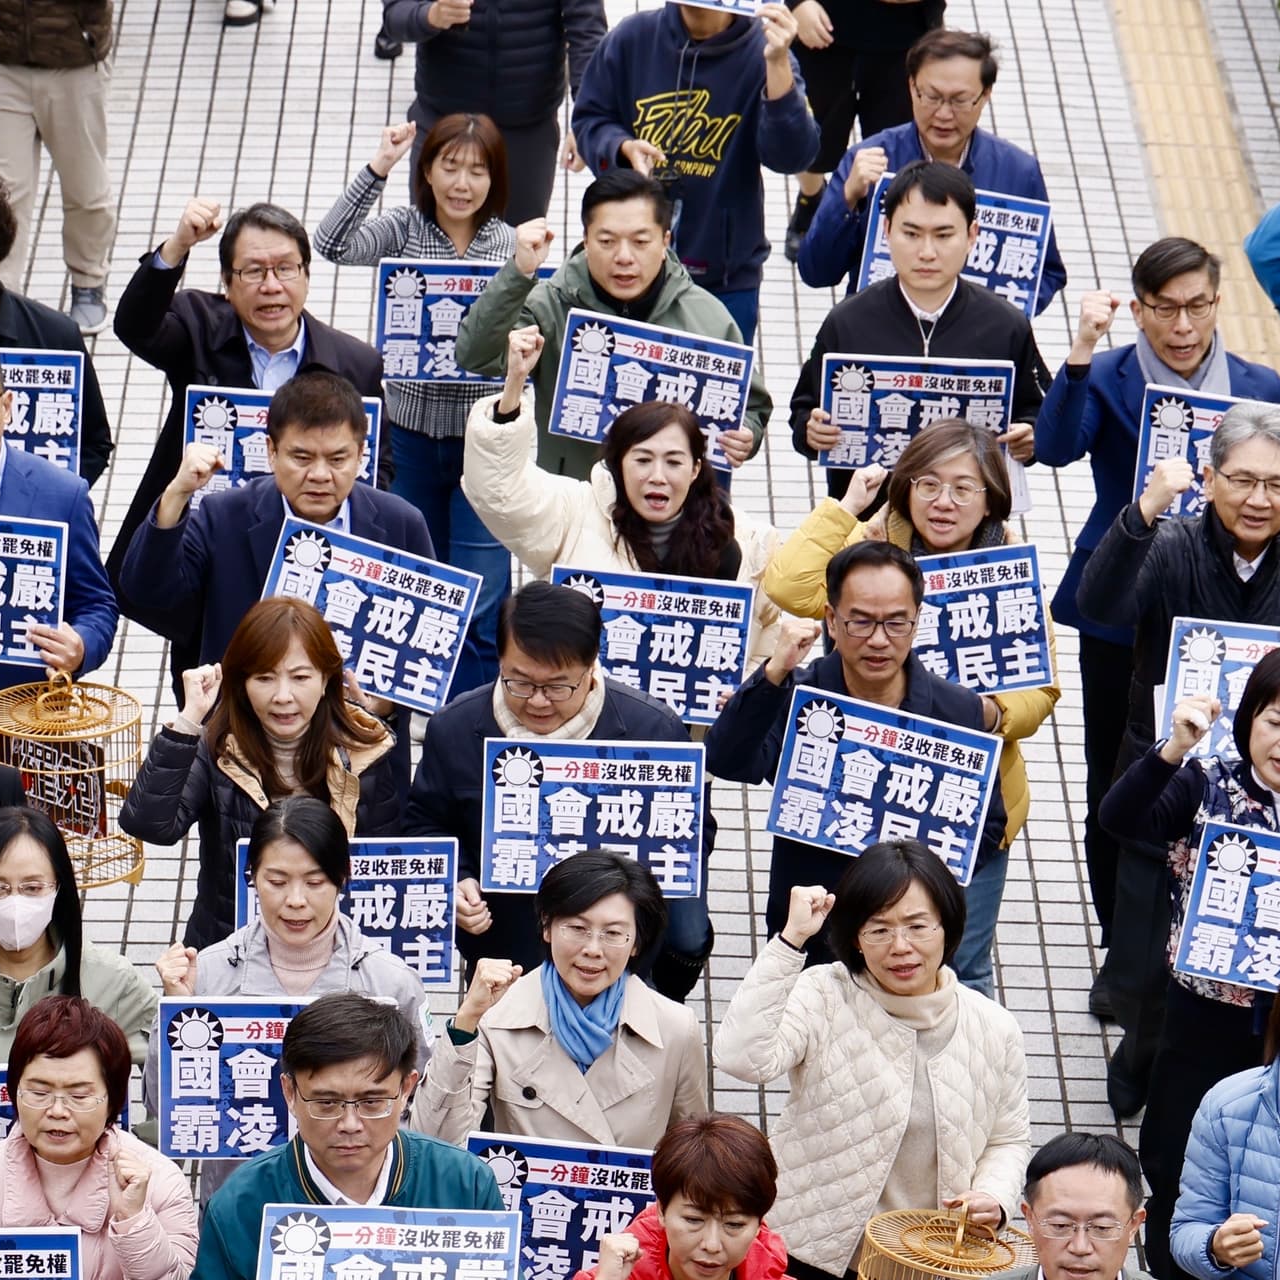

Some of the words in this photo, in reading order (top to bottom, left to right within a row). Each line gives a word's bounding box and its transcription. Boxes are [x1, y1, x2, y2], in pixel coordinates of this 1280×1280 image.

[617, 341, 742, 377] 一分鐘沒收罷免權
[566, 353, 740, 423] 國會戒嚴
[876, 375, 1003, 394] 一分鐘沒收罷免權
[333, 555, 465, 607] 一分鐘沒收罷免權
[922, 562, 1030, 591] 鐘沒收罷免權
[607, 591, 743, 620] 一分鐘沒收罷免權
[847, 725, 984, 770] 一分鐘沒收罷免權
[545, 761, 692, 783] 一分鐘沒收罷免權
[787, 738, 981, 827] 國會戒嚴
[493, 787, 696, 840] 國會戒嚴
[349, 857, 446, 876] 沒收罷免權
[529, 1162, 656, 1191] 一分鐘沒收罷
[332, 1228, 506, 1250] 一分鐘沒收罷免權
